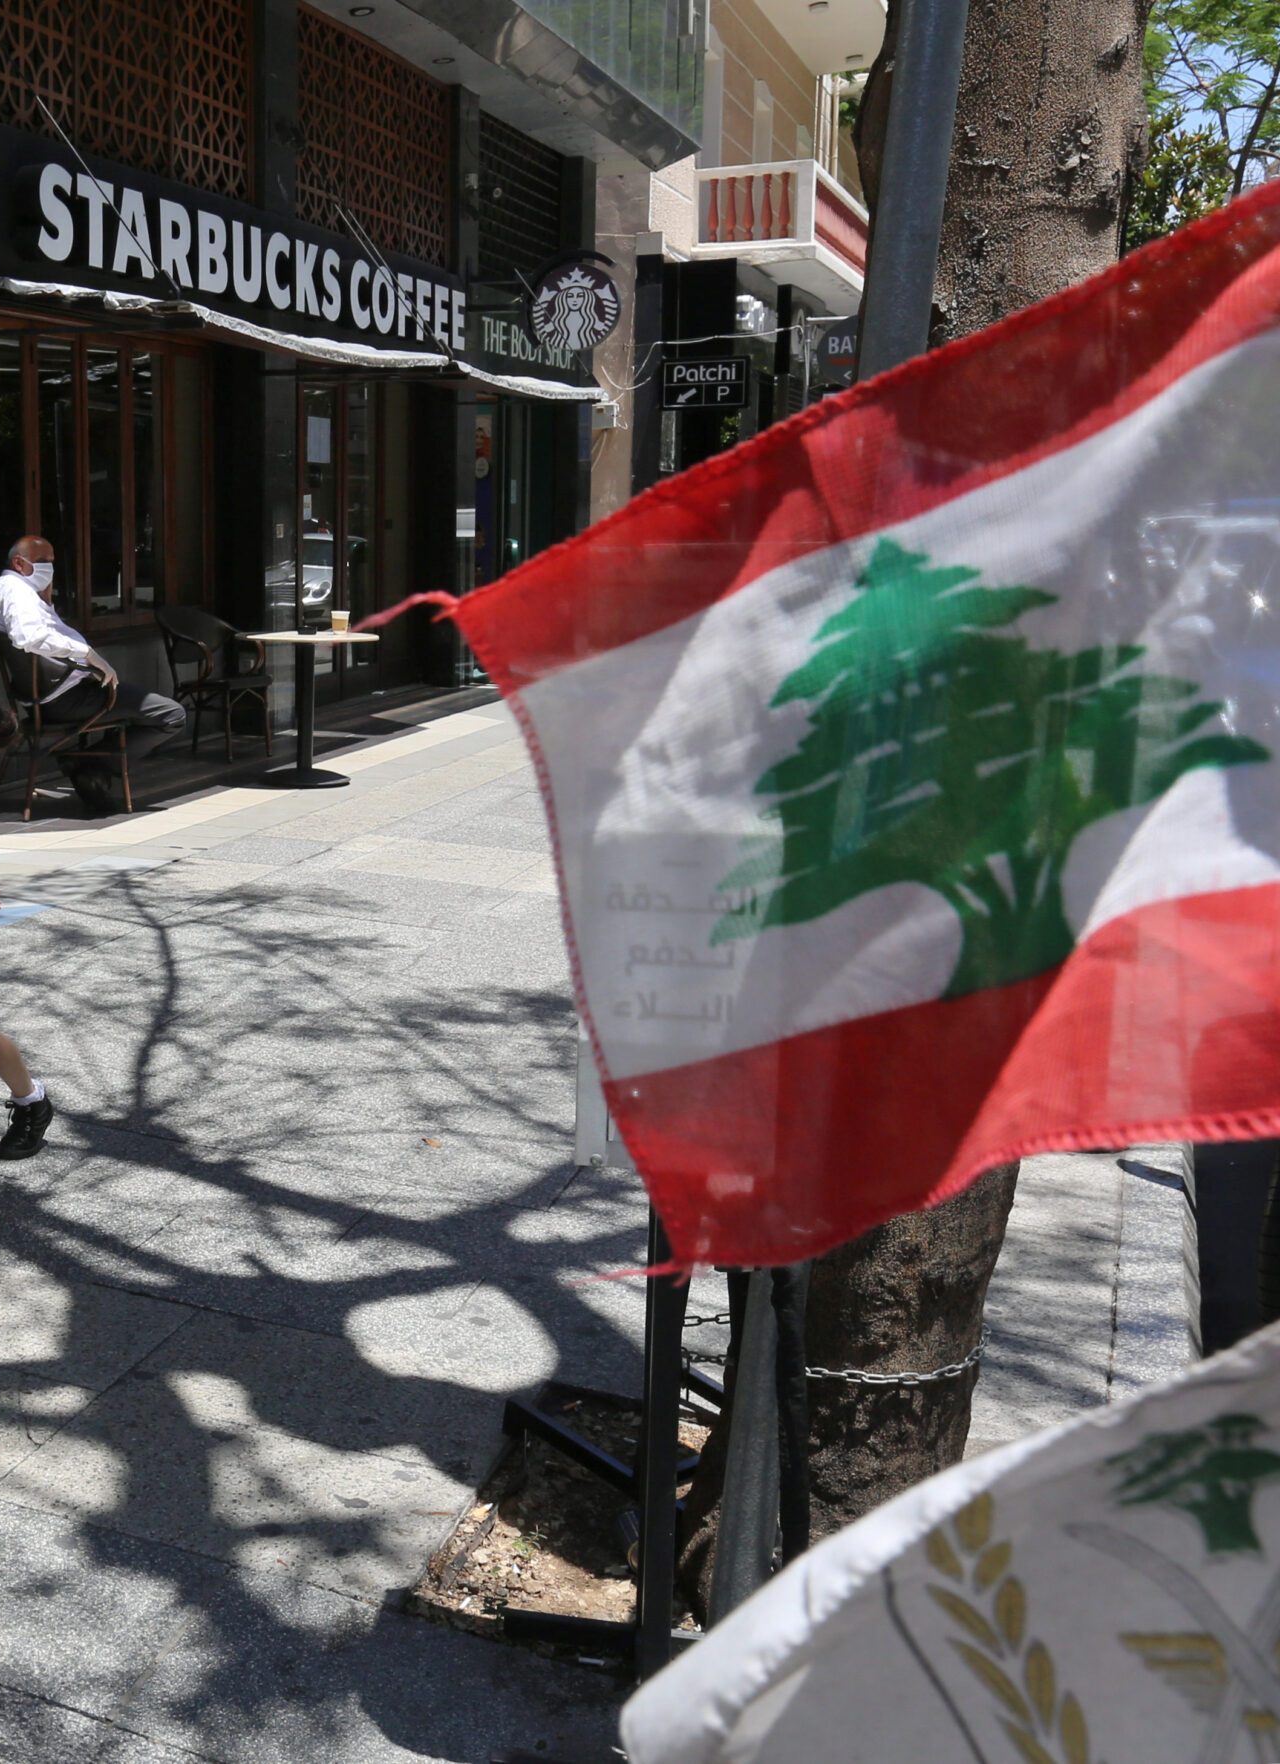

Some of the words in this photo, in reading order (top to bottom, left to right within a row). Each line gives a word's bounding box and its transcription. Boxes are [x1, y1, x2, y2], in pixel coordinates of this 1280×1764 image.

[38, 162, 342, 322] STARBUCKS
[350, 258, 467, 351] COFFEE
[481, 316, 508, 356] THE
[828, 335, 857, 354] BA
[673, 364, 736, 383] Patchi
[717, 386, 730, 402] P
